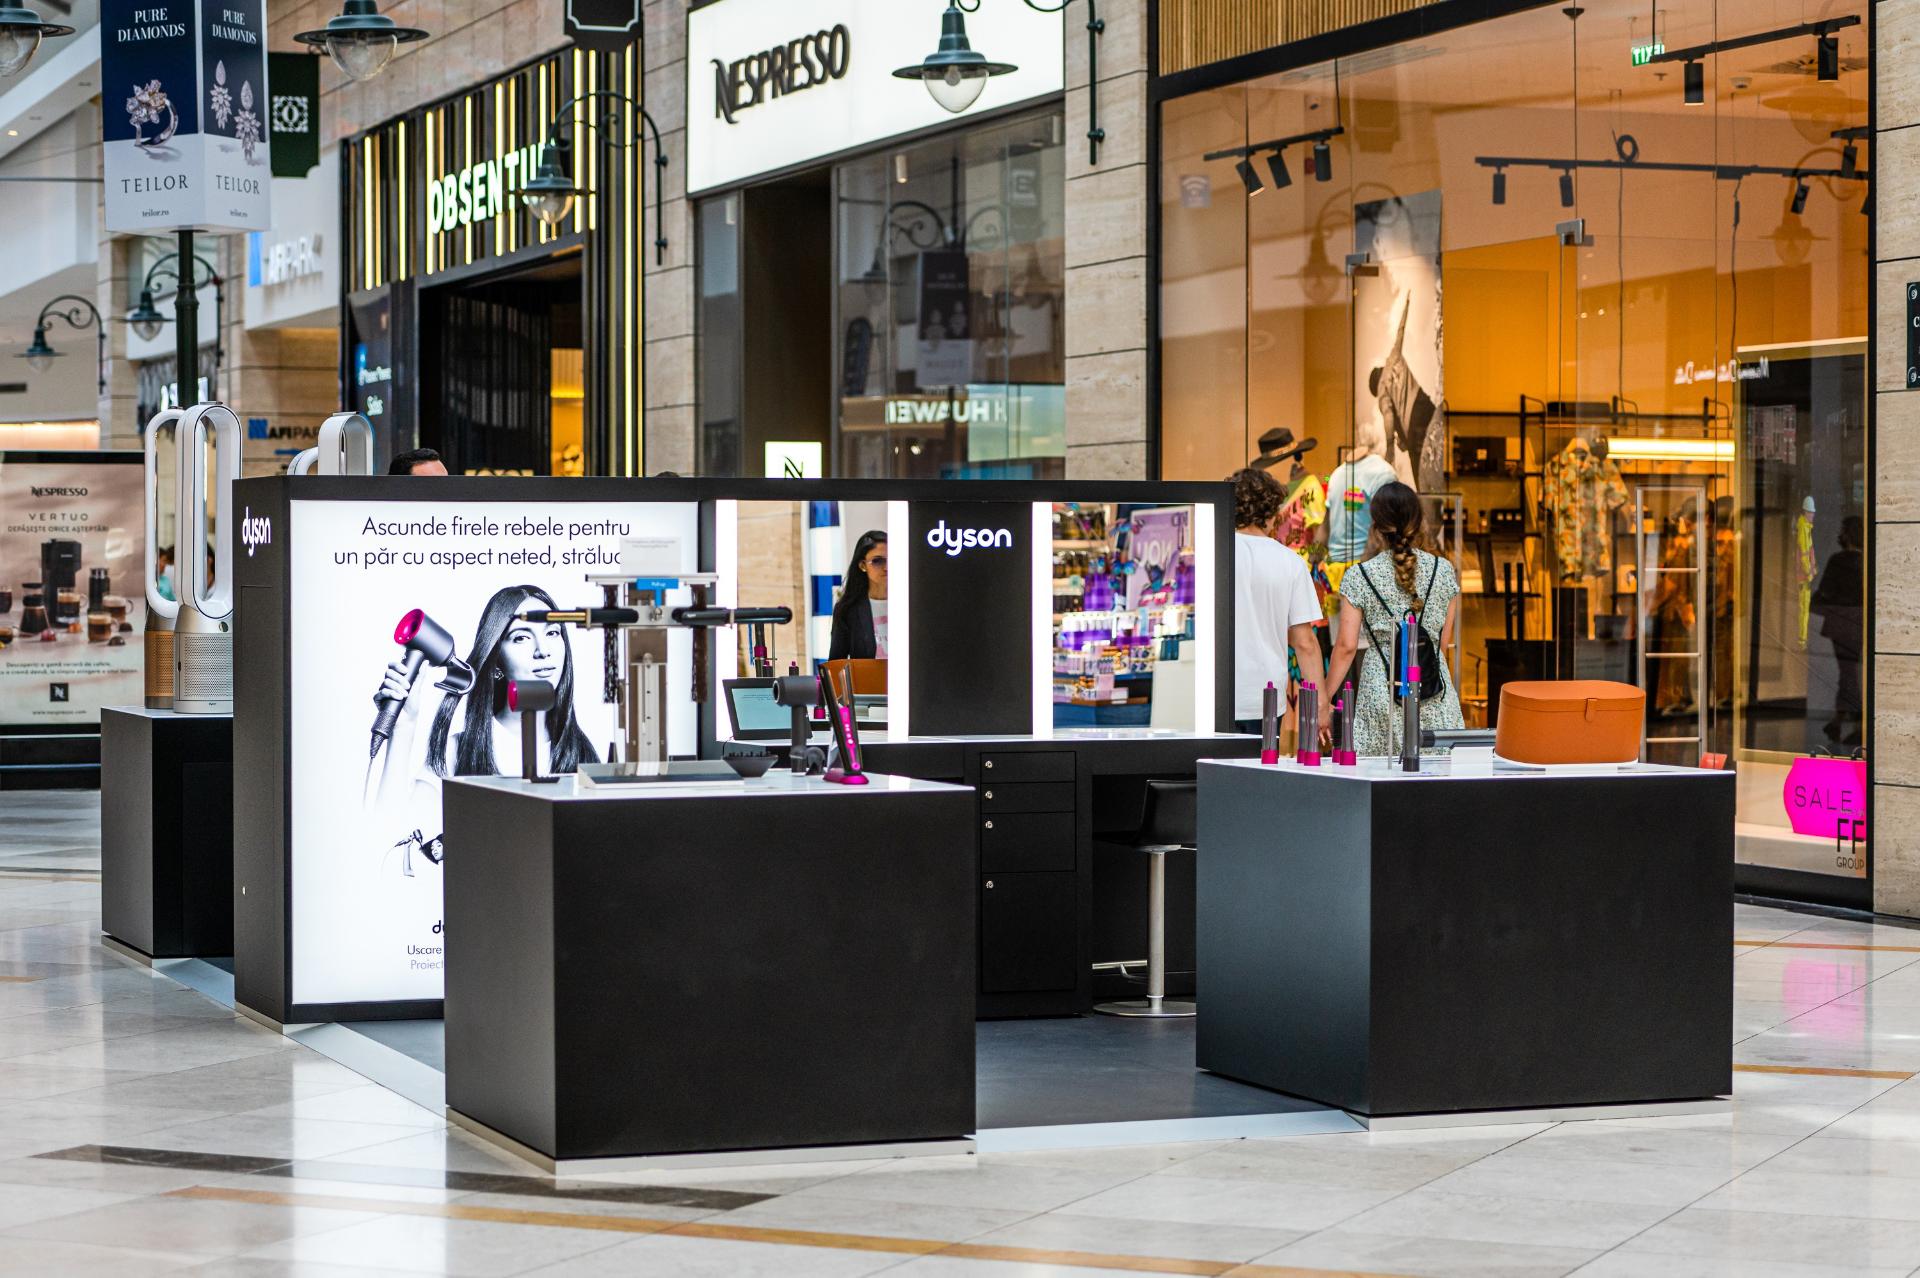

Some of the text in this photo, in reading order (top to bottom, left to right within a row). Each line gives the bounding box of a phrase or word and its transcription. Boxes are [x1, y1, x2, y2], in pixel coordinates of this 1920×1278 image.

[134, 8, 168, 24] PURE
[222, 9, 246, 26] PURE
[117, 23, 186, 42] DIAMONDS
[212, 24, 257, 44] DIAMONDS
[710, 23, 851, 125] NESPRESSO
[121, 174, 189, 194] TEILOR
[216, 174, 260, 195] TEILOR
[142, 208, 170, 218] teilor.ro
[30, 485, 89, 498] NESPRESSO
[28, 512, 89, 521] VERTUO
[242, 506, 272, 557] dyson
[362, 515, 630, 541] Ascunde firele rebele pentru
[927, 520, 1012, 556] dyson
[334, 551, 358, 565] un
[364, 547, 399, 570] păr
[402, 551, 424, 565] cu
[430, 548, 494, 570] aspect
[498, 545, 557, 568] neted,
[1794, 785, 1852, 812] SALE
[1836, 817, 1865, 855] FF
[1836, 856, 1865, 870] GROUP
[407, 944, 442, 955] Uscare
